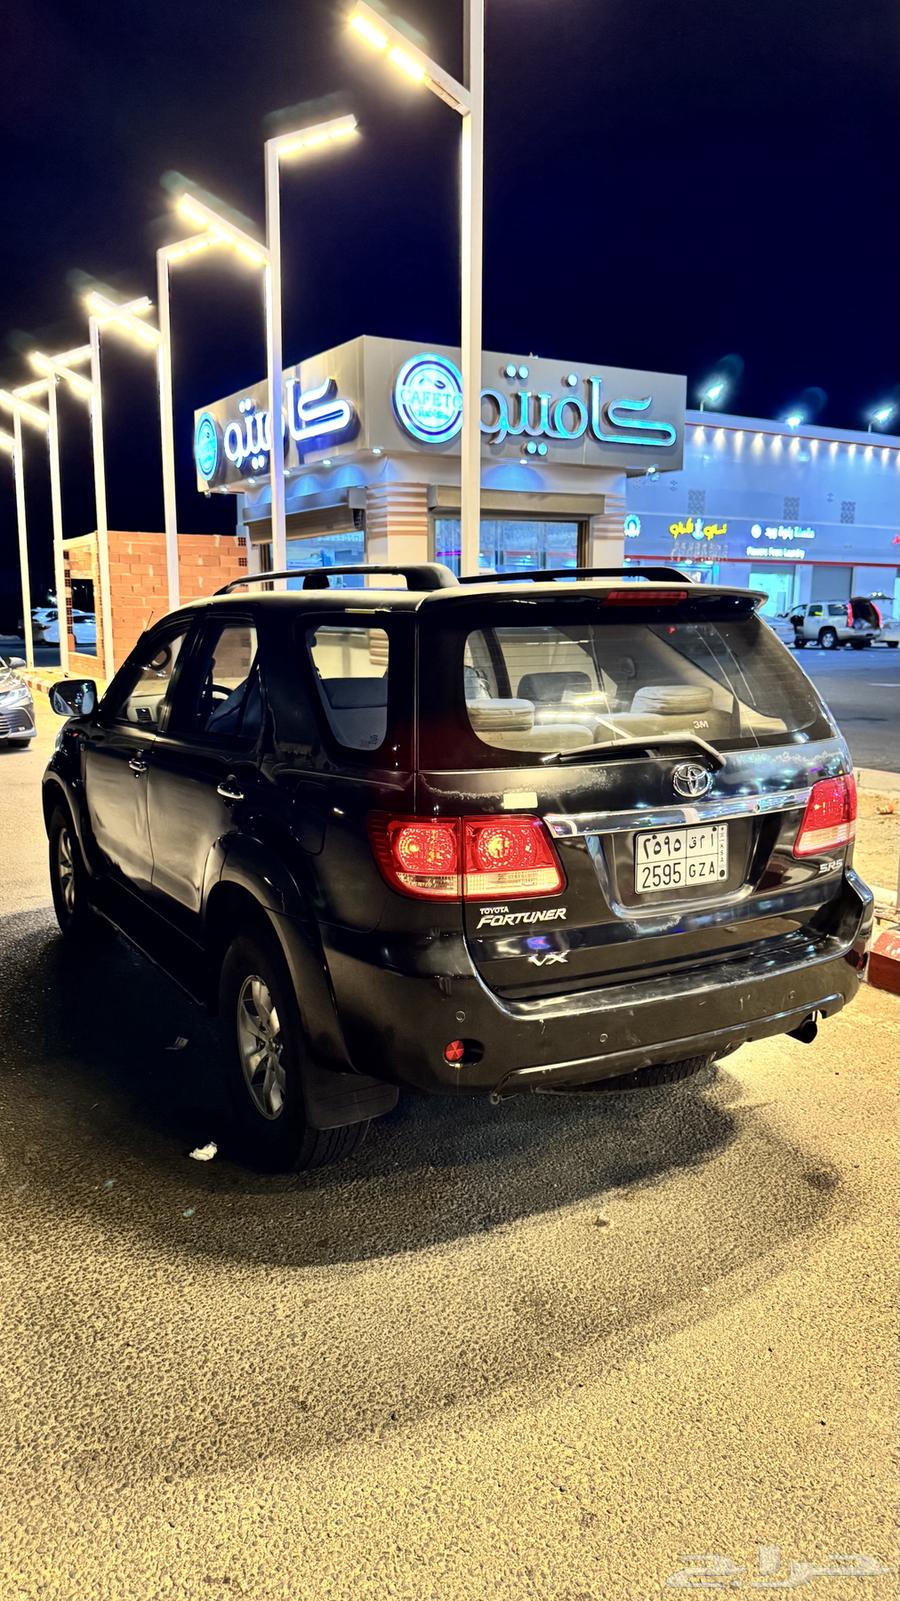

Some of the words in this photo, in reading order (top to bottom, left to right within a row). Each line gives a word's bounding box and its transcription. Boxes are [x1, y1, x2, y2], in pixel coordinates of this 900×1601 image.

[479, 363, 677, 456] كافيتو
[692, 719, 710, 729] 3M
[643, 835, 682, 860] ٢٥٩٥
[642, 862, 682, 889] 2595
[688, 861, 716, 878] GZA
[476, 907, 567, 930] FORTUNER
[479, 906, 509, 915] TOYOTA
[528, 949, 571, 967] VX
